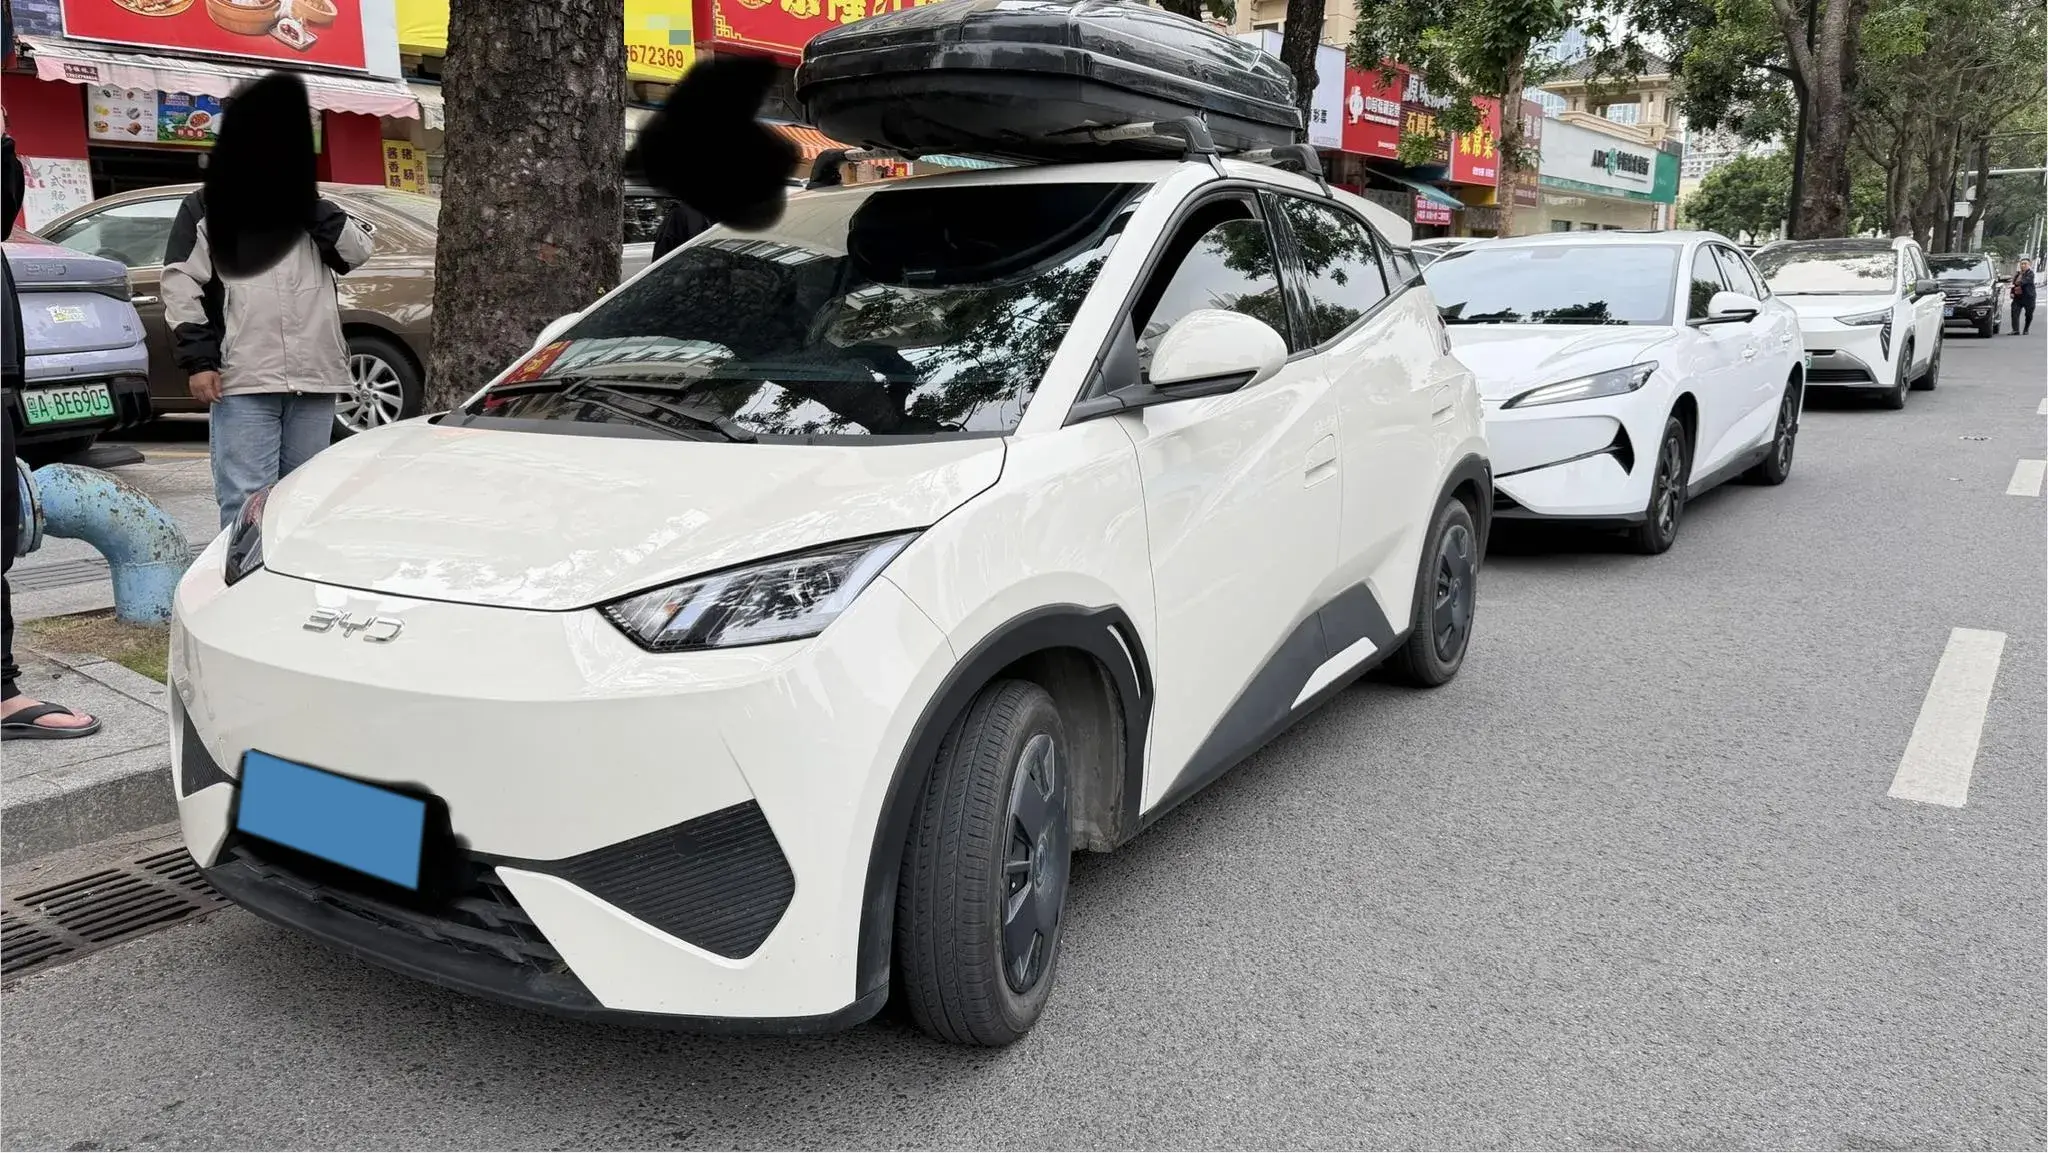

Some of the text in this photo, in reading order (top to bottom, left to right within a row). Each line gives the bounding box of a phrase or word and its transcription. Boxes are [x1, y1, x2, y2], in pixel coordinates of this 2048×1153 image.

[1460, 124, 1494, 159] 家常菜
[302, 607, 406, 644] BYD
